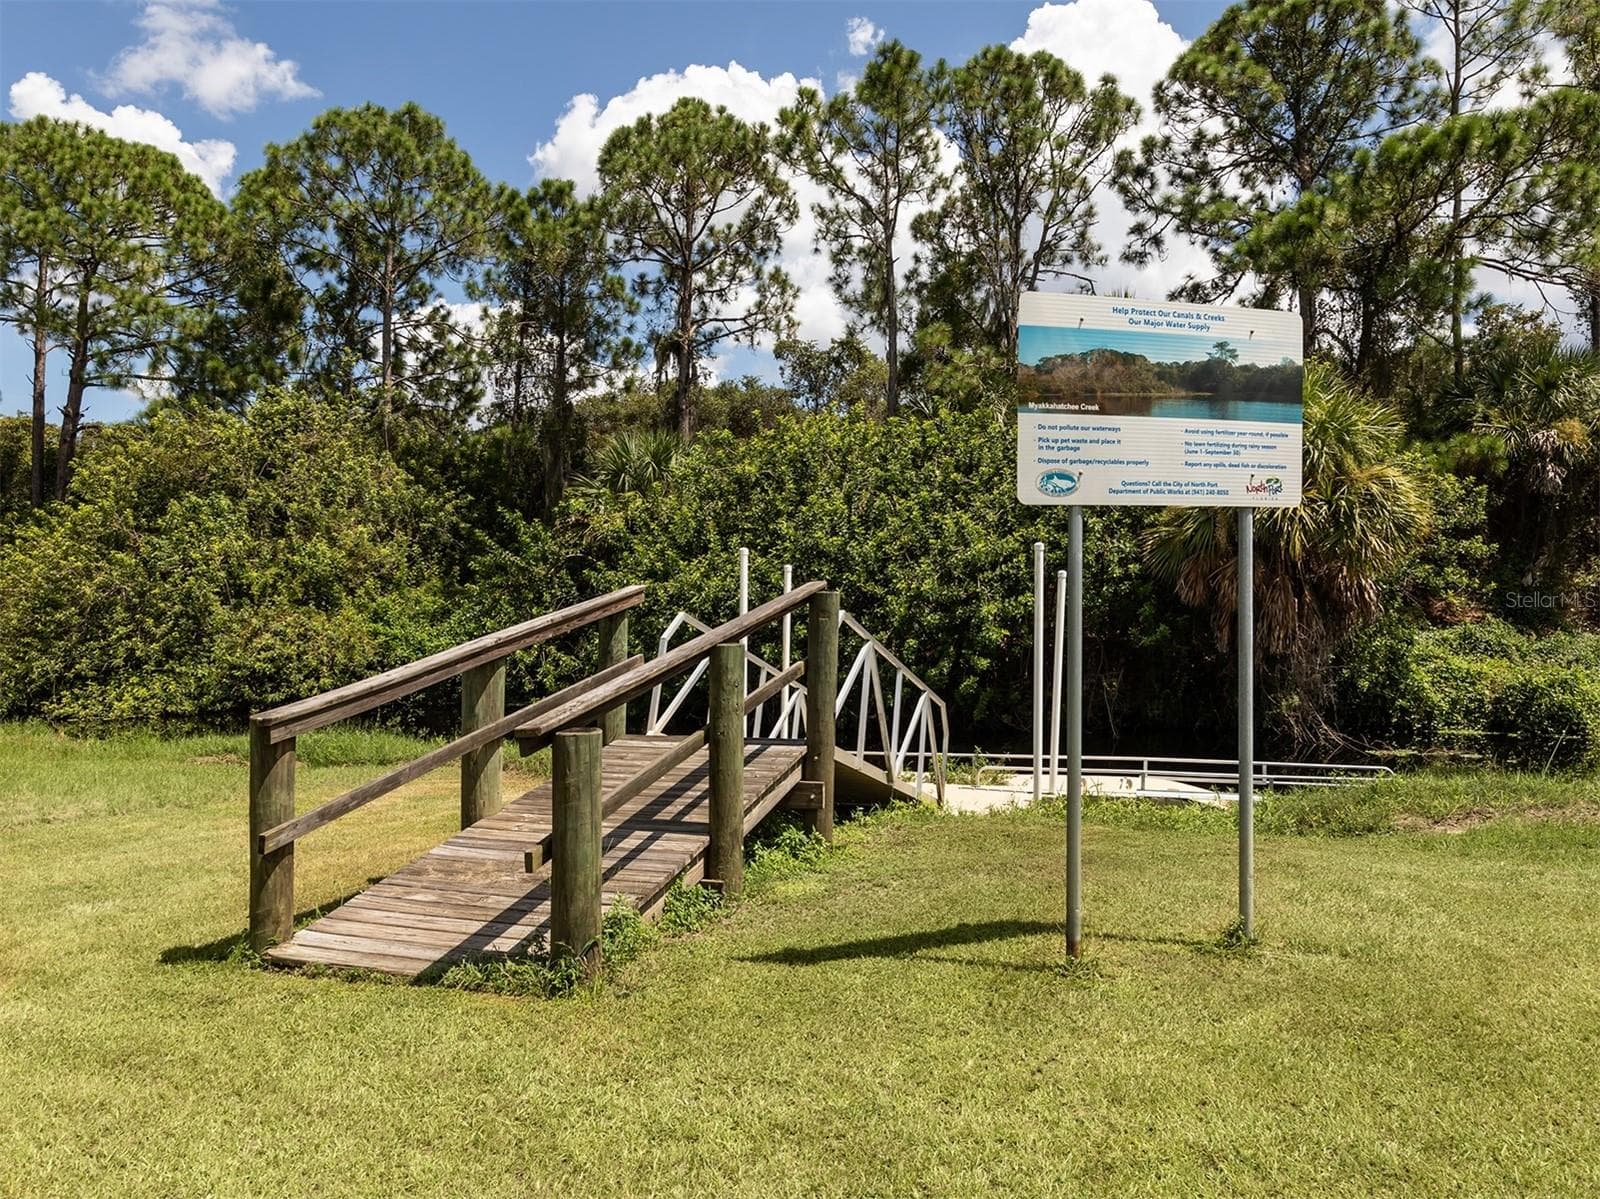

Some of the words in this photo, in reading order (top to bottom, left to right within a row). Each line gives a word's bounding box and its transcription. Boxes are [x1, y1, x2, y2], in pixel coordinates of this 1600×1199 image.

[1112, 306, 1129, 316] Help
[1131, 307, 1156, 316] Protect
[1172, 311, 1194, 319] Canals
[1203, 313, 1225, 322] Creeks
[1143, 319, 1164, 328] Major
[1166, 320, 1186, 328] Water
[1188, 322, 1210, 332] Supply
[1028, 402, 1079, 410] Myakkahatchee
[1080, 402, 1100, 411] Creek
